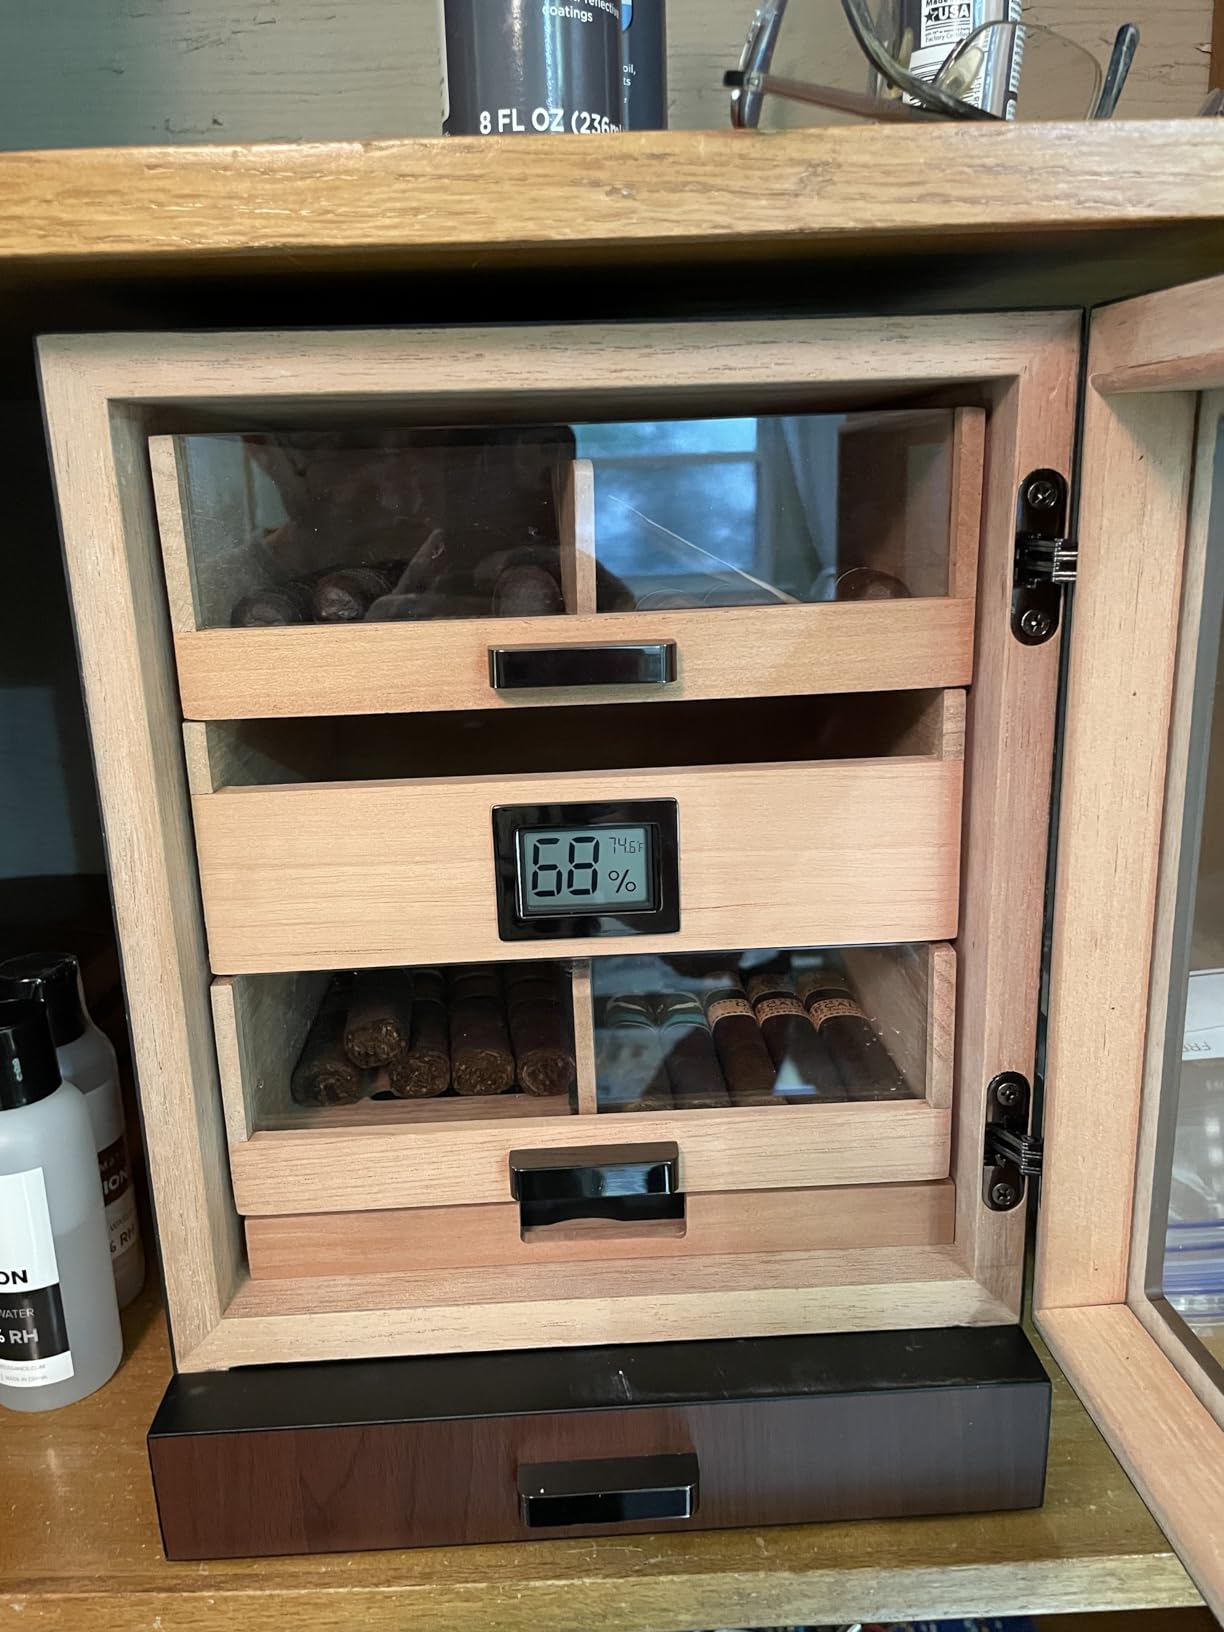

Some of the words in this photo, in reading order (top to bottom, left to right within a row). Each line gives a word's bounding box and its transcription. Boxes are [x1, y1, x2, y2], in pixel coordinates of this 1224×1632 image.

[542, 4, 593, 23] coatings
[938, 4, 970, 20] USA
[622, 63, 637, 76] oil,
[479, 110, 492, 135] 8
[498, 108, 525, 132] FL
[531, 107, 564, 132] OZ
[531, 836, 600, 898] 68
[608, 869, 637, 894] %
[8, 1328, 39, 1344] RH
